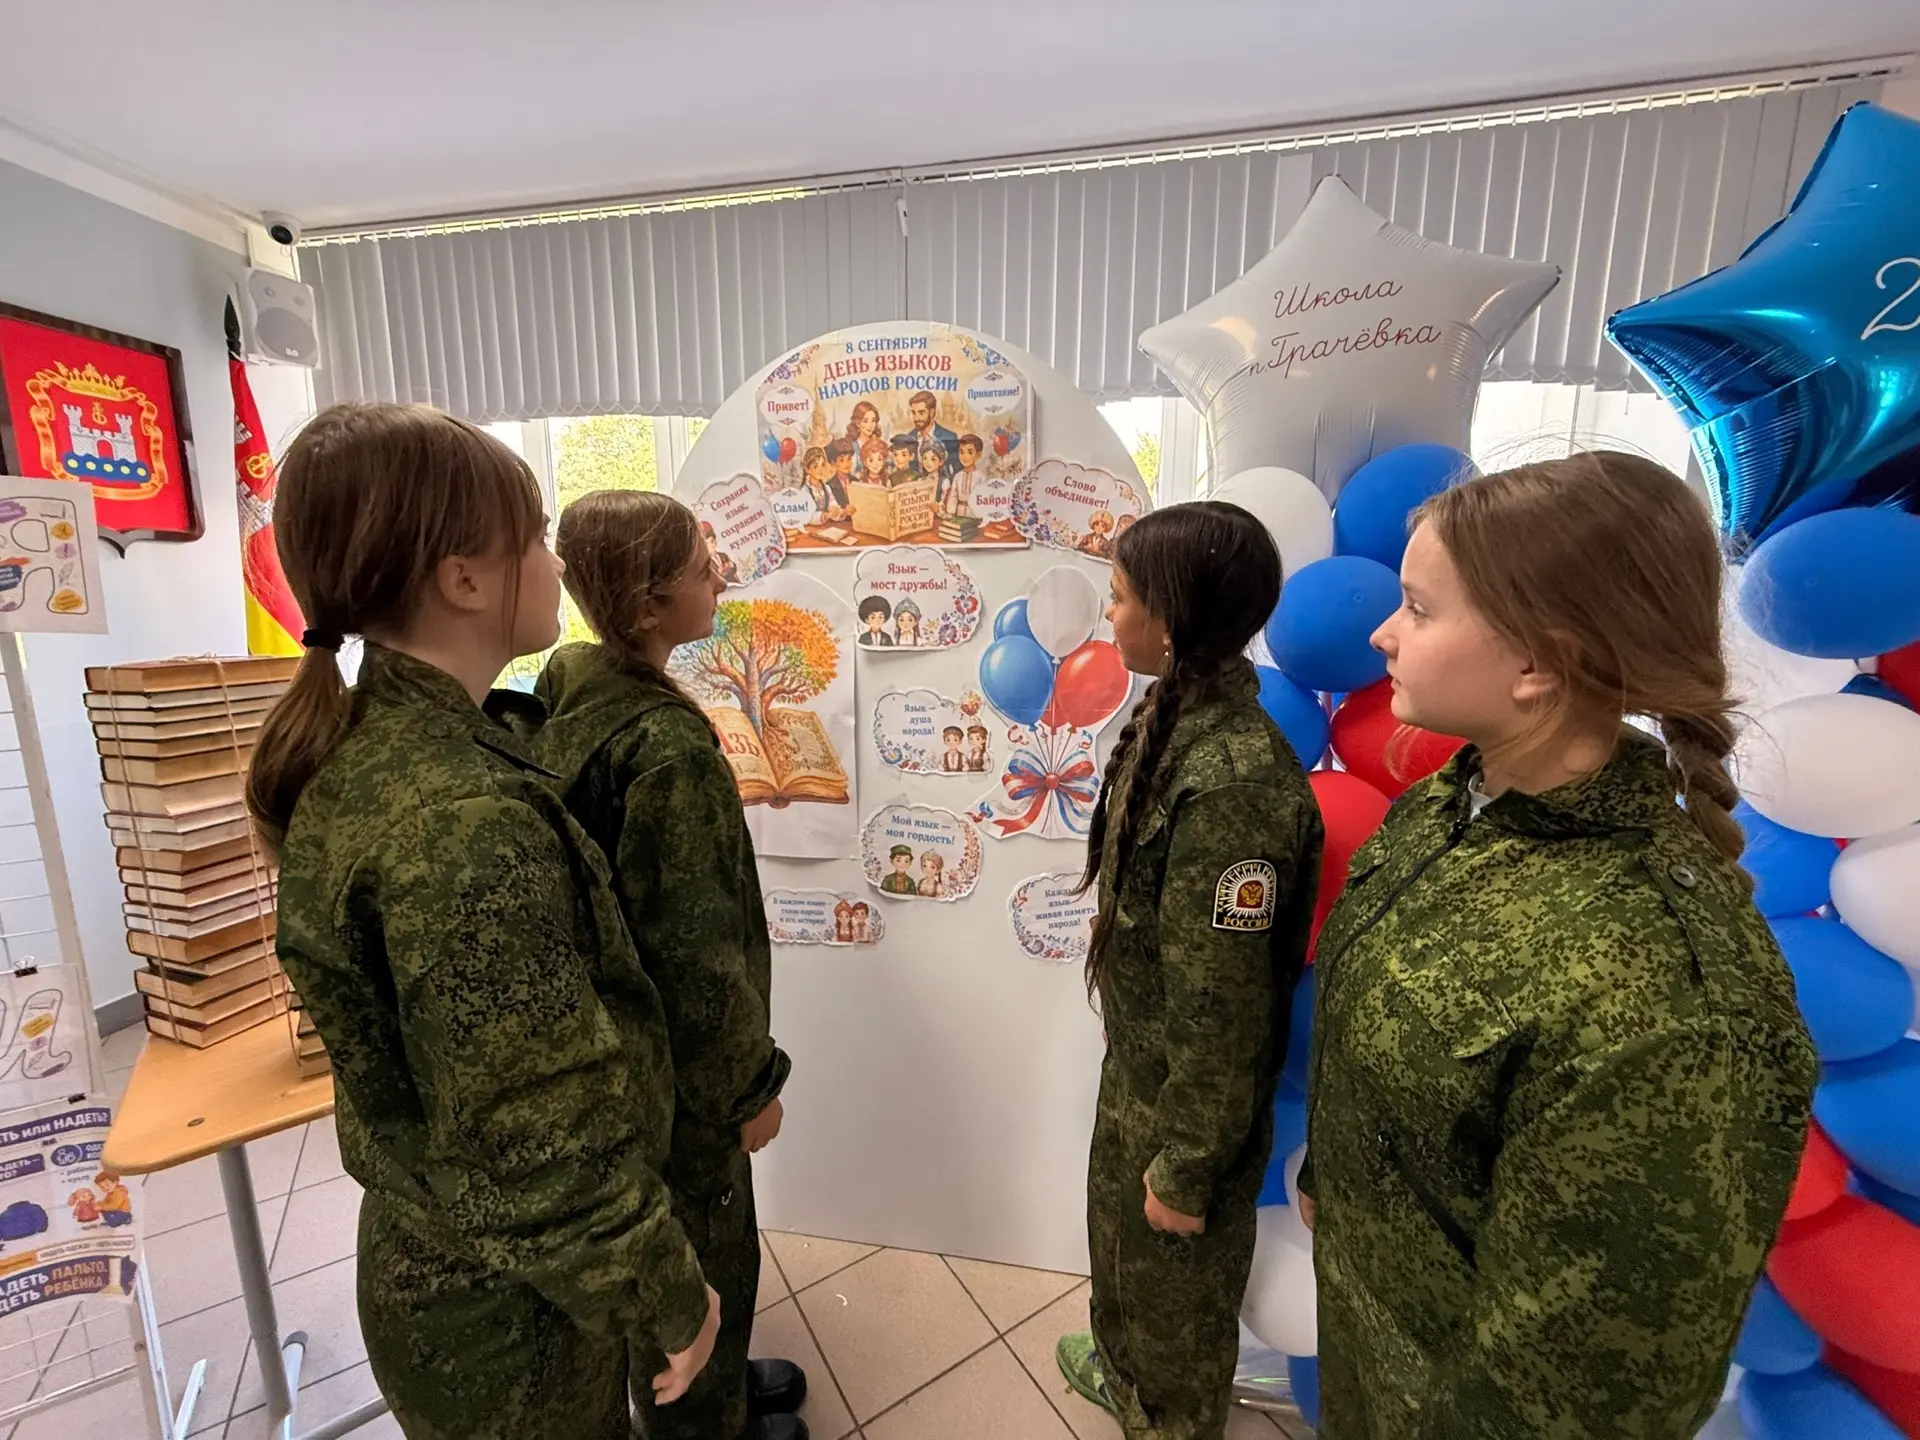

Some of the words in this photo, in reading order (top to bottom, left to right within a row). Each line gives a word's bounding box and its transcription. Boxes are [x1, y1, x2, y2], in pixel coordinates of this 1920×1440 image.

[1274, 280, 1403, 319] Школа
[845, 342, 854, 354] 8
[858, 337, 928, 353] СЕНТЯБРЯ
[823, 357, 870, 383] ДЕНЬ
[874, 354, 952, 372] ЯЗЫКОВ
[818, 376, 890, 401] НАРОДОВ
[895, 375, 959, 392] РОССИИ
[767, 399, 810, 414] Привет!
[1063, 475, 1097, 493] Слово
[710, 484, 750, 512] Сохраняя
[976, 494, 1011, 507] Байра
[1044, 485, 1110, 509] объединяет!
[725, 503, 750, 520] язык,
[773, 502, 809, 514] Салам!
[720, 510, 765, 539] сохраняем
[729, 523, 769, 551] культуру
[887, 563, 917, 574] Язык
[870, 581, 897, 590] мост
[899, 578, 947, 593] дружбы!
[904, 704, 927, 712] Язык
[910, 716, 932, 726] душа
[902, 725, 935, 737] народа!
[891, 814, 912, 825] Мой
[914, 820, 940, 829] язык
[885, 828, 905, 838] моя
[907, 831, 955, 845] гордость!
[1035, 912, 1063, 920] живая
[1064, 907, 1096, 917] память
[1048, 917, 1081, 929] народа!
[53, 1112, 108, 1129] НАДЕТЬ?
